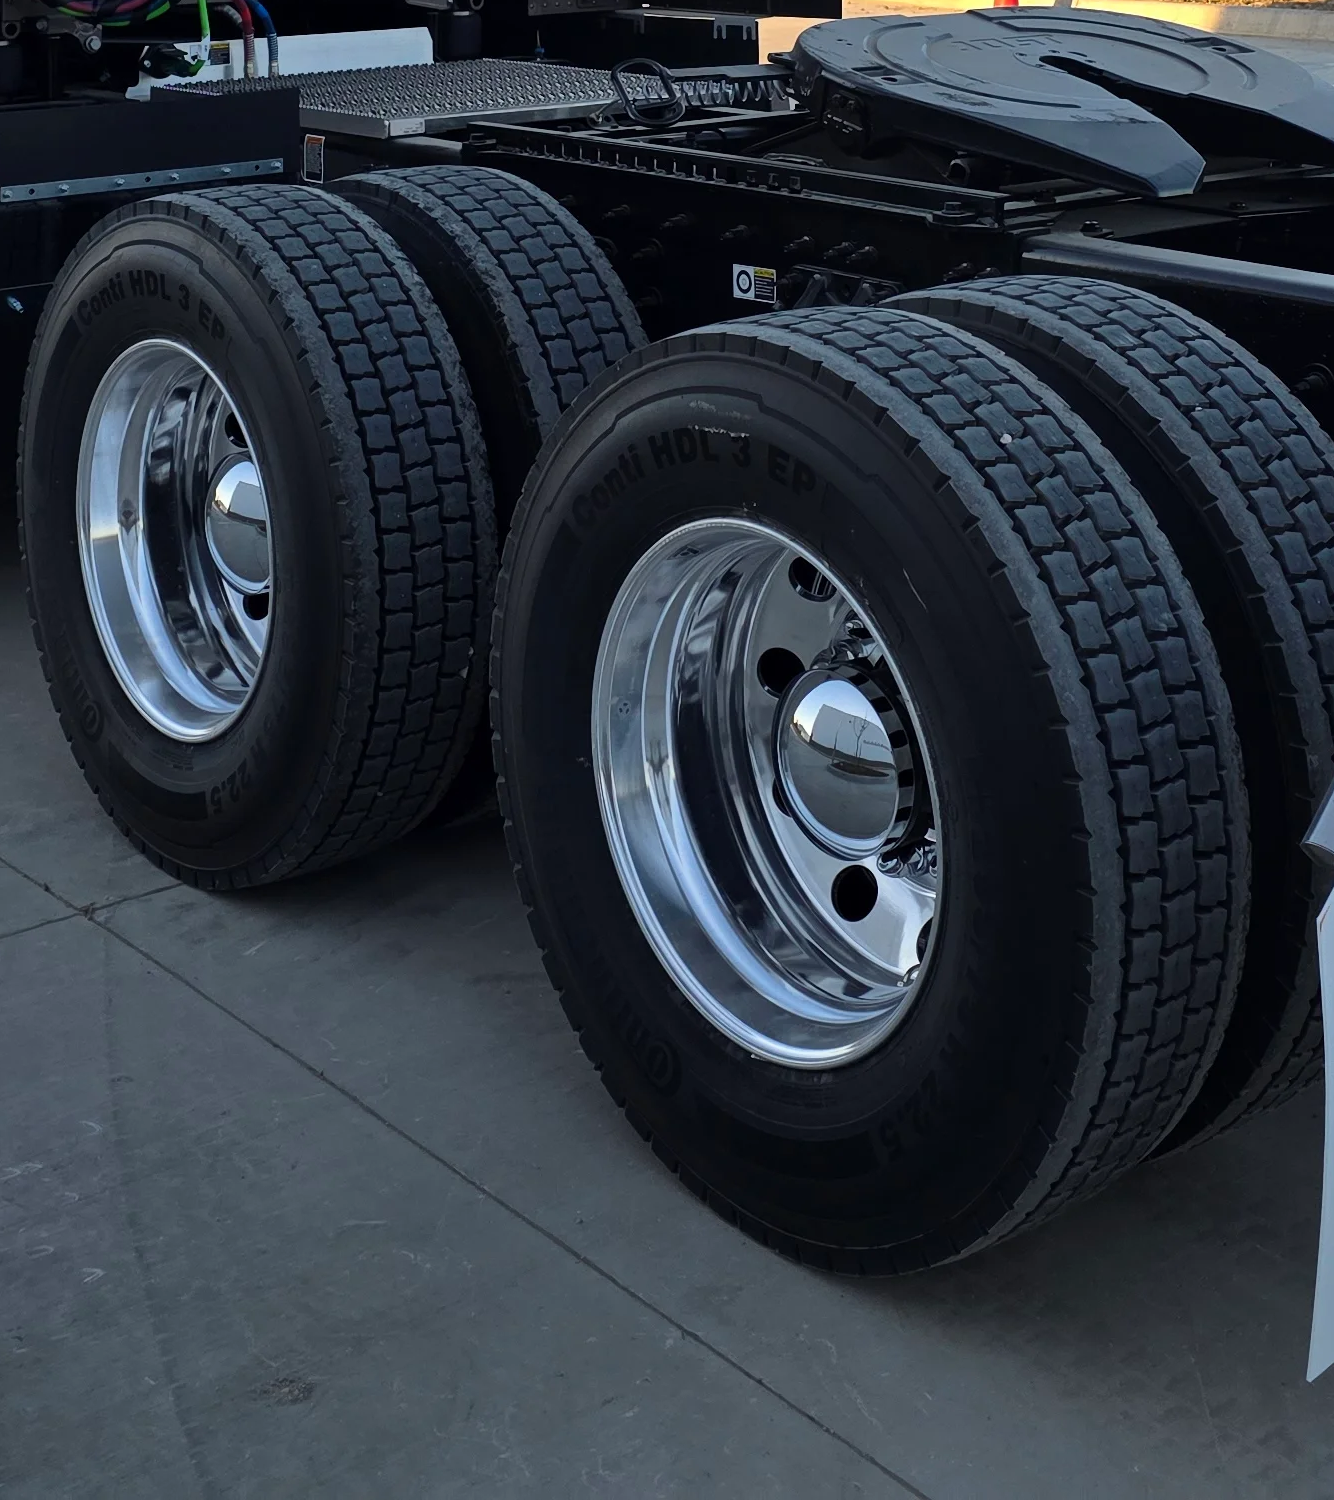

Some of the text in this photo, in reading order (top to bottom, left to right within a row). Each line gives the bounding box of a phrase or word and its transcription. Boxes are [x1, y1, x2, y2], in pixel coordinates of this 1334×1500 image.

[77, 269, 225, 340] Conti HDL 3 EP
[571, 427, 817, 528] Conti HDL 3 EP
